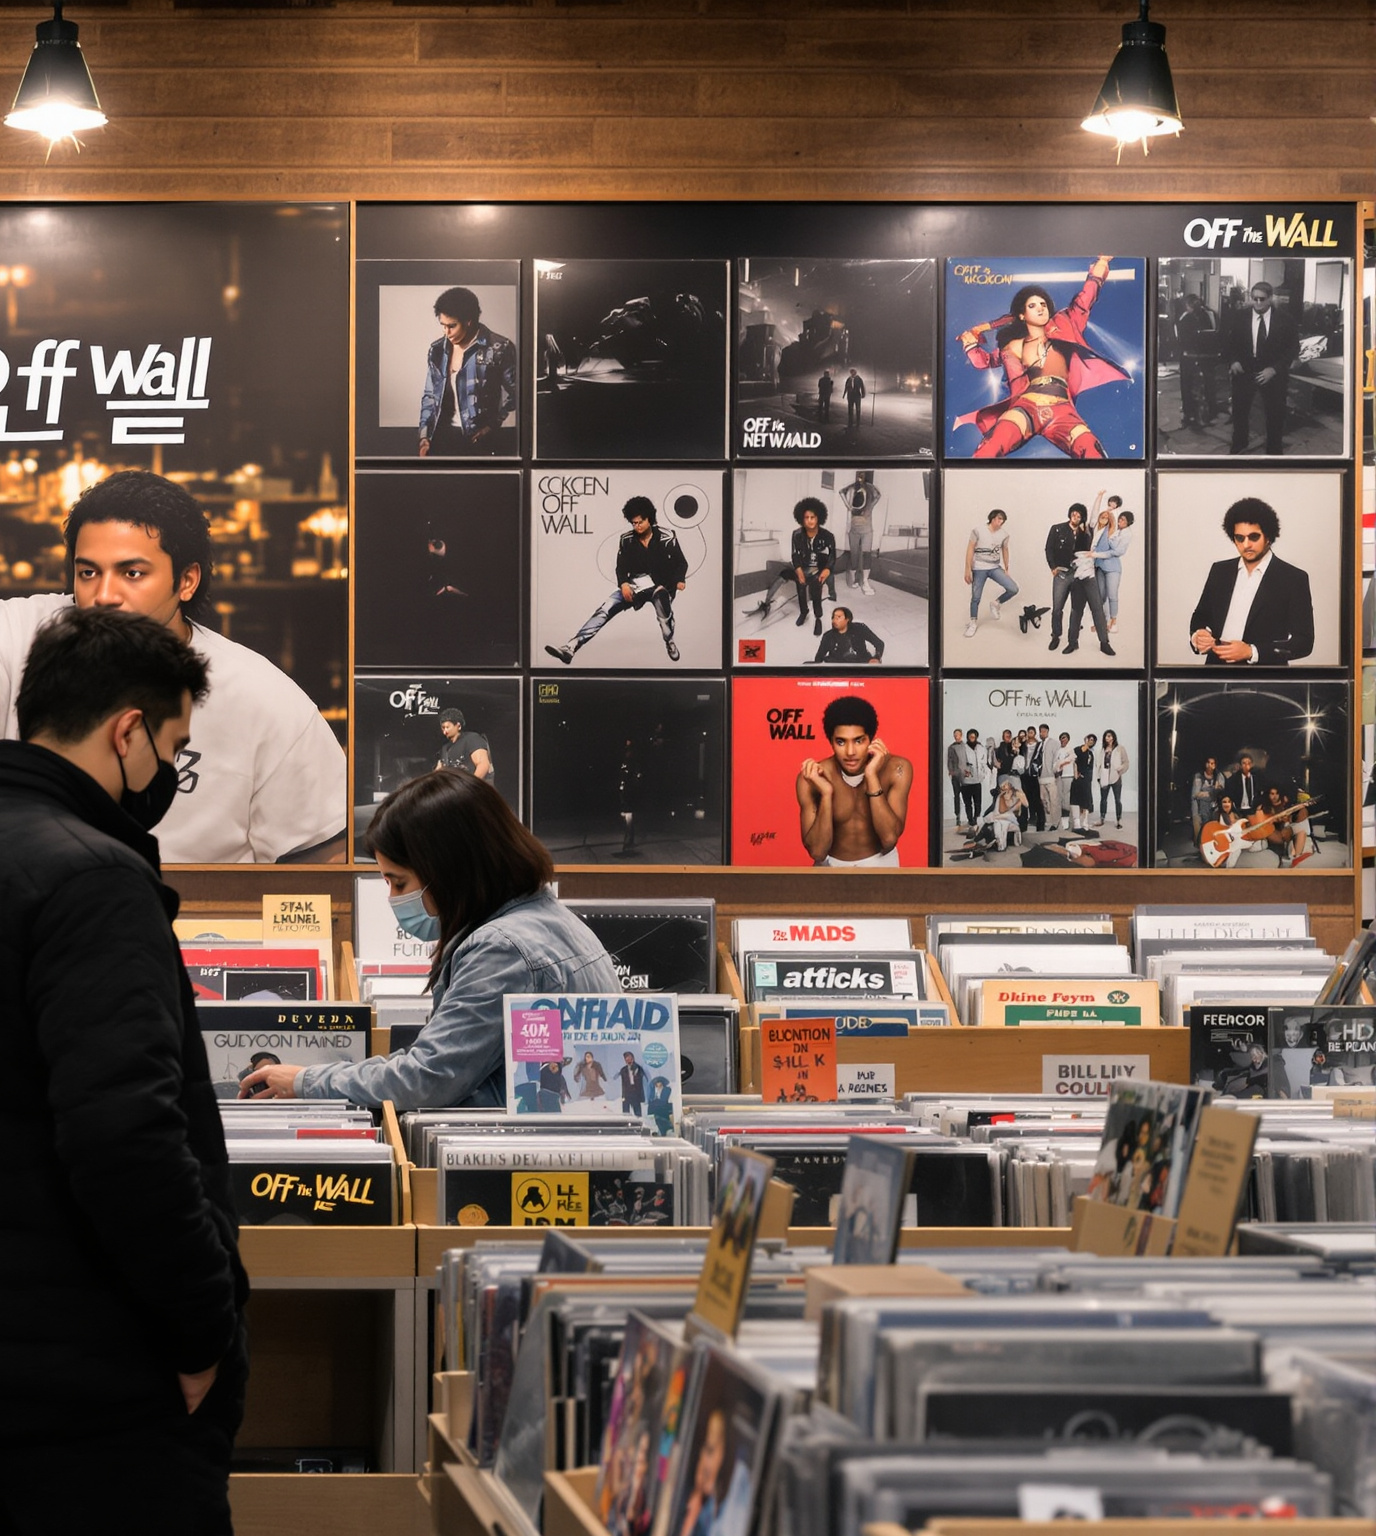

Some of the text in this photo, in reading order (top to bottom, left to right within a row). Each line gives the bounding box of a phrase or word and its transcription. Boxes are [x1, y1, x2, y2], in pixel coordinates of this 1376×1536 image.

[1183, 218, 1243, 249] OFF
[1265, 212, 1339, 248] WALL
[743, 417, 771, 433] OFF
[542, 494, 580, 514] OFF
[541, 514, 594, 535] WALL
[988, 689, 1024, 707] OFF
[1045, 689, 1092, 708] WALL
[766, 708, 804, 723] OFF
[769, 724, 816, 740] WALL
[789, 925, 856, 942] MADS
[1058, 1064, 1097, 1079] BILL
[251, 1172, 300, 1202] OFF
[315, 1173, 374, 1205] WALL
